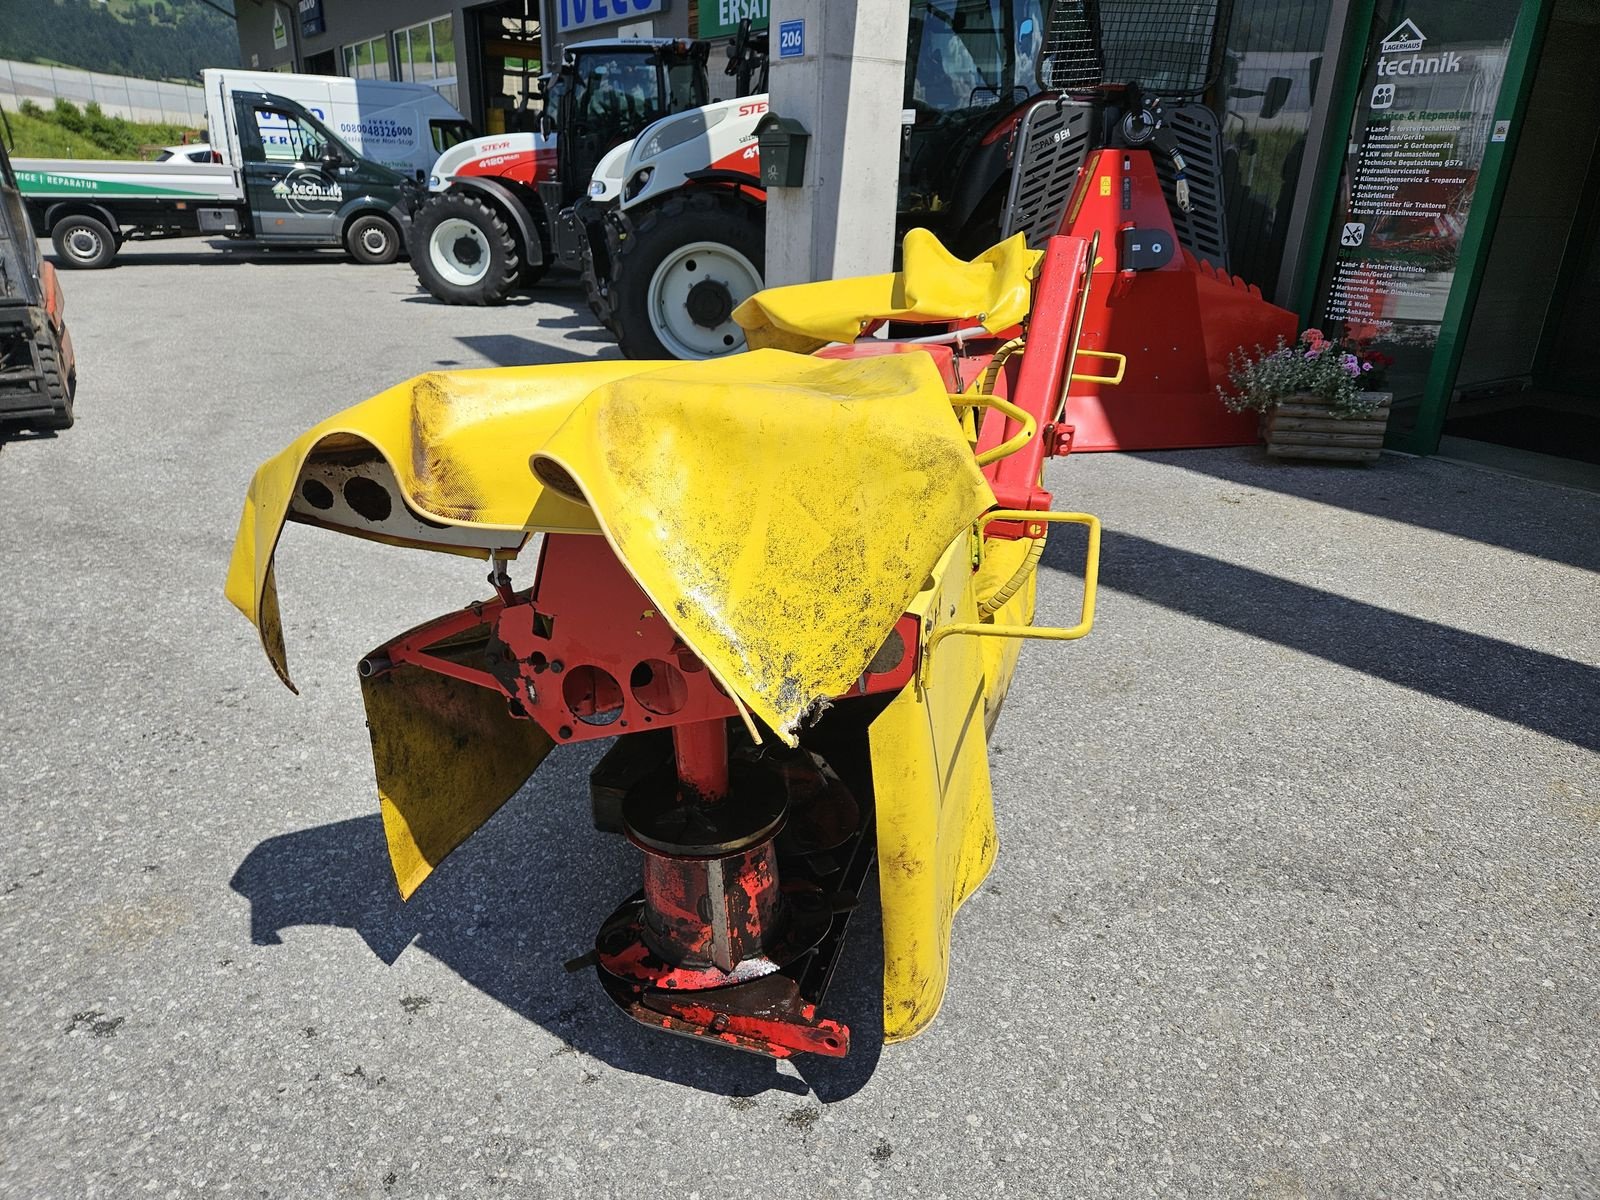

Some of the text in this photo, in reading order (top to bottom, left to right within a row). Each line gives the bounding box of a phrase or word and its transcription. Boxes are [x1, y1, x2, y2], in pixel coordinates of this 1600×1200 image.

[561, 0, 650, 28] IVECO
[781, 30, 801, 48] 206
[1384, 42, 1421, 51] LAGERHAUS
[1377, 51, 1462, 76] technik
[1419, 110, 1472, 122] Reparatur
[481, 141, 510, 152] STEYR
[1411, 142, 1454, 150] Gartengeräte
[1444, 159, 1463, 167] §57a
[47, 176, 98, 189] REPARATUR
[292, 181, 343, 196] technik
[1354, 200, 1402, 208] Leistungstester
[1375, 209, 1441, 218] Ersatzteilversorgung
[1366, 263, 1426, 273] forstwirtschaftliche
[1340, 269, 1393, 279] Maschinen/Geräte
[1337, 277, 1369, 285] Kommunal
[1336, 284, 1374, 293] Markenreifen
[1334, 292, 1369, 300] Melktechnik
[1331, 307, 1375, 317] PKW-Anhänger
